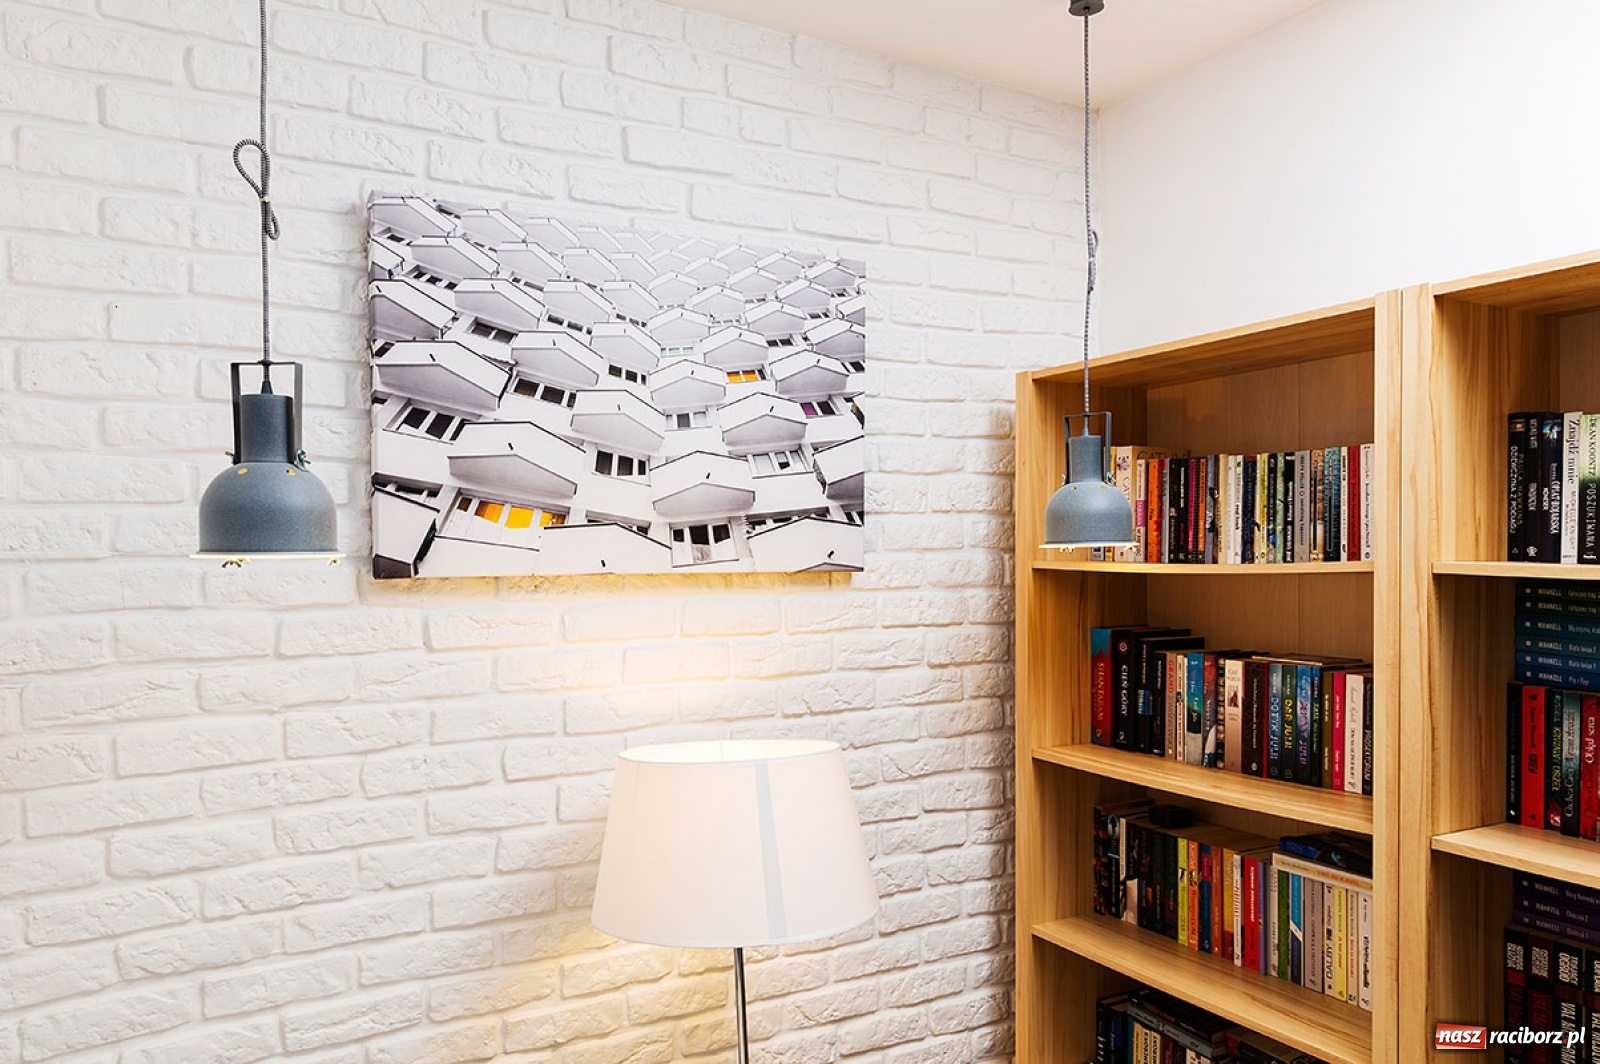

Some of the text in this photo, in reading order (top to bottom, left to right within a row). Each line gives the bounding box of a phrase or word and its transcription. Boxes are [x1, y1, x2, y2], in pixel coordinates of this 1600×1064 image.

[1566, 419, 1580, 484] Znajdź mnie
[1588, 441, 1596, 477] KOONTZ
[1586, 483, 1597, 548] POSZUKIWANA
[1096, 662, 1105, 720] SHANTARAM
[1120, 689, 1129, 717] GÓRY
[1270, 697, 1279, 732] DOTYK
[1284, 698, 1294, 721] DAR
[1552, 726, 1562, 762] KRWAWY
